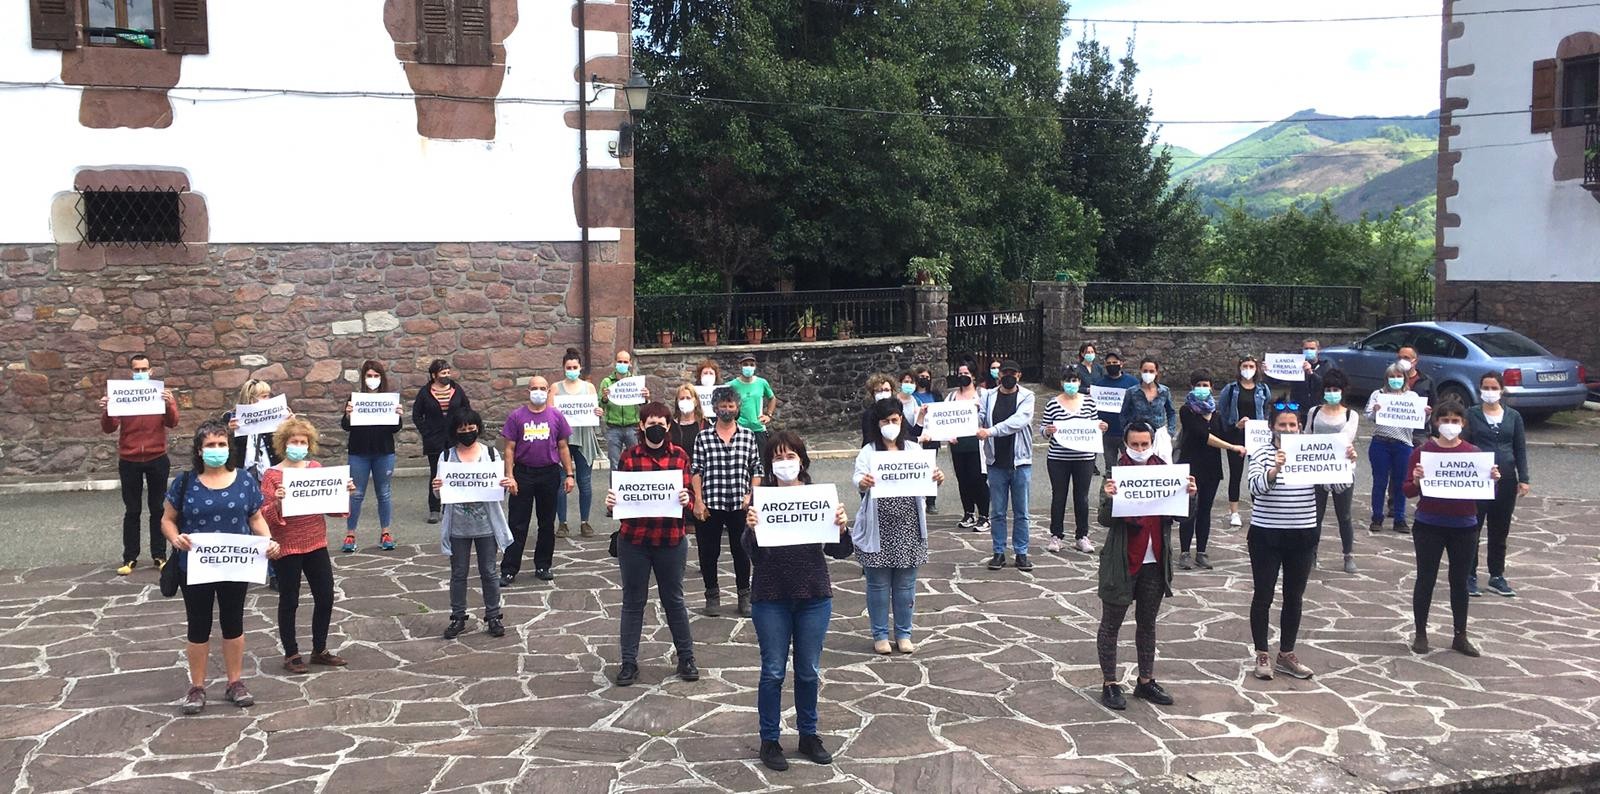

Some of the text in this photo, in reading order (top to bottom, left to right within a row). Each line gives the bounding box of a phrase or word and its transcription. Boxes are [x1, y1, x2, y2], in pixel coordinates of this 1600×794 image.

[955, 315, 986, 327] IRUIN
[113, 388, 158, 396] AROZTEGIA
[116, 395, 151, 403] GELDITU
[241, 406, 284, 418] AROZTEGIA
[932, 409, 973, 417] AROZTEGIA
[244, 415, 277, 424] GELDITU
[936, 417, 966, 425] GELDITU
[1379, 413, 1419, 421] DEFENDATU
[1300, 443, 1333, 451] LANDA
[1296, 453, 1336, 462] EREMUA
[877, 462, 930, 471] AROZTEGIA
[1284, 464, 1342, 473] DEFENDATU
[881, 472, 920, 481] GELDITU
[1435, 470, 1479, 478] EREMUA
[289, 478, 343, 488] AROZTEGIA
[449, 480, 488, 488] GELDITU
[618, 483, 675, 491] AROZTEGIA
[1119, 478, 1181, 488] AROZTEGIA
[1423, 480, 1485, 488] DEFENDATU
[292, 488, 332, 498] GELDITU
[622, 493, 665, 501] GELDITU
[1124, 490, 1170, 499] GELDITU
[761, 500, 830, 512] AROZTEGIA
[766, 513, 818, 524] GELDITU
[195, 545, 259, 555] AROZTEGIA
[200, 555, 248, 564] GELDITU
